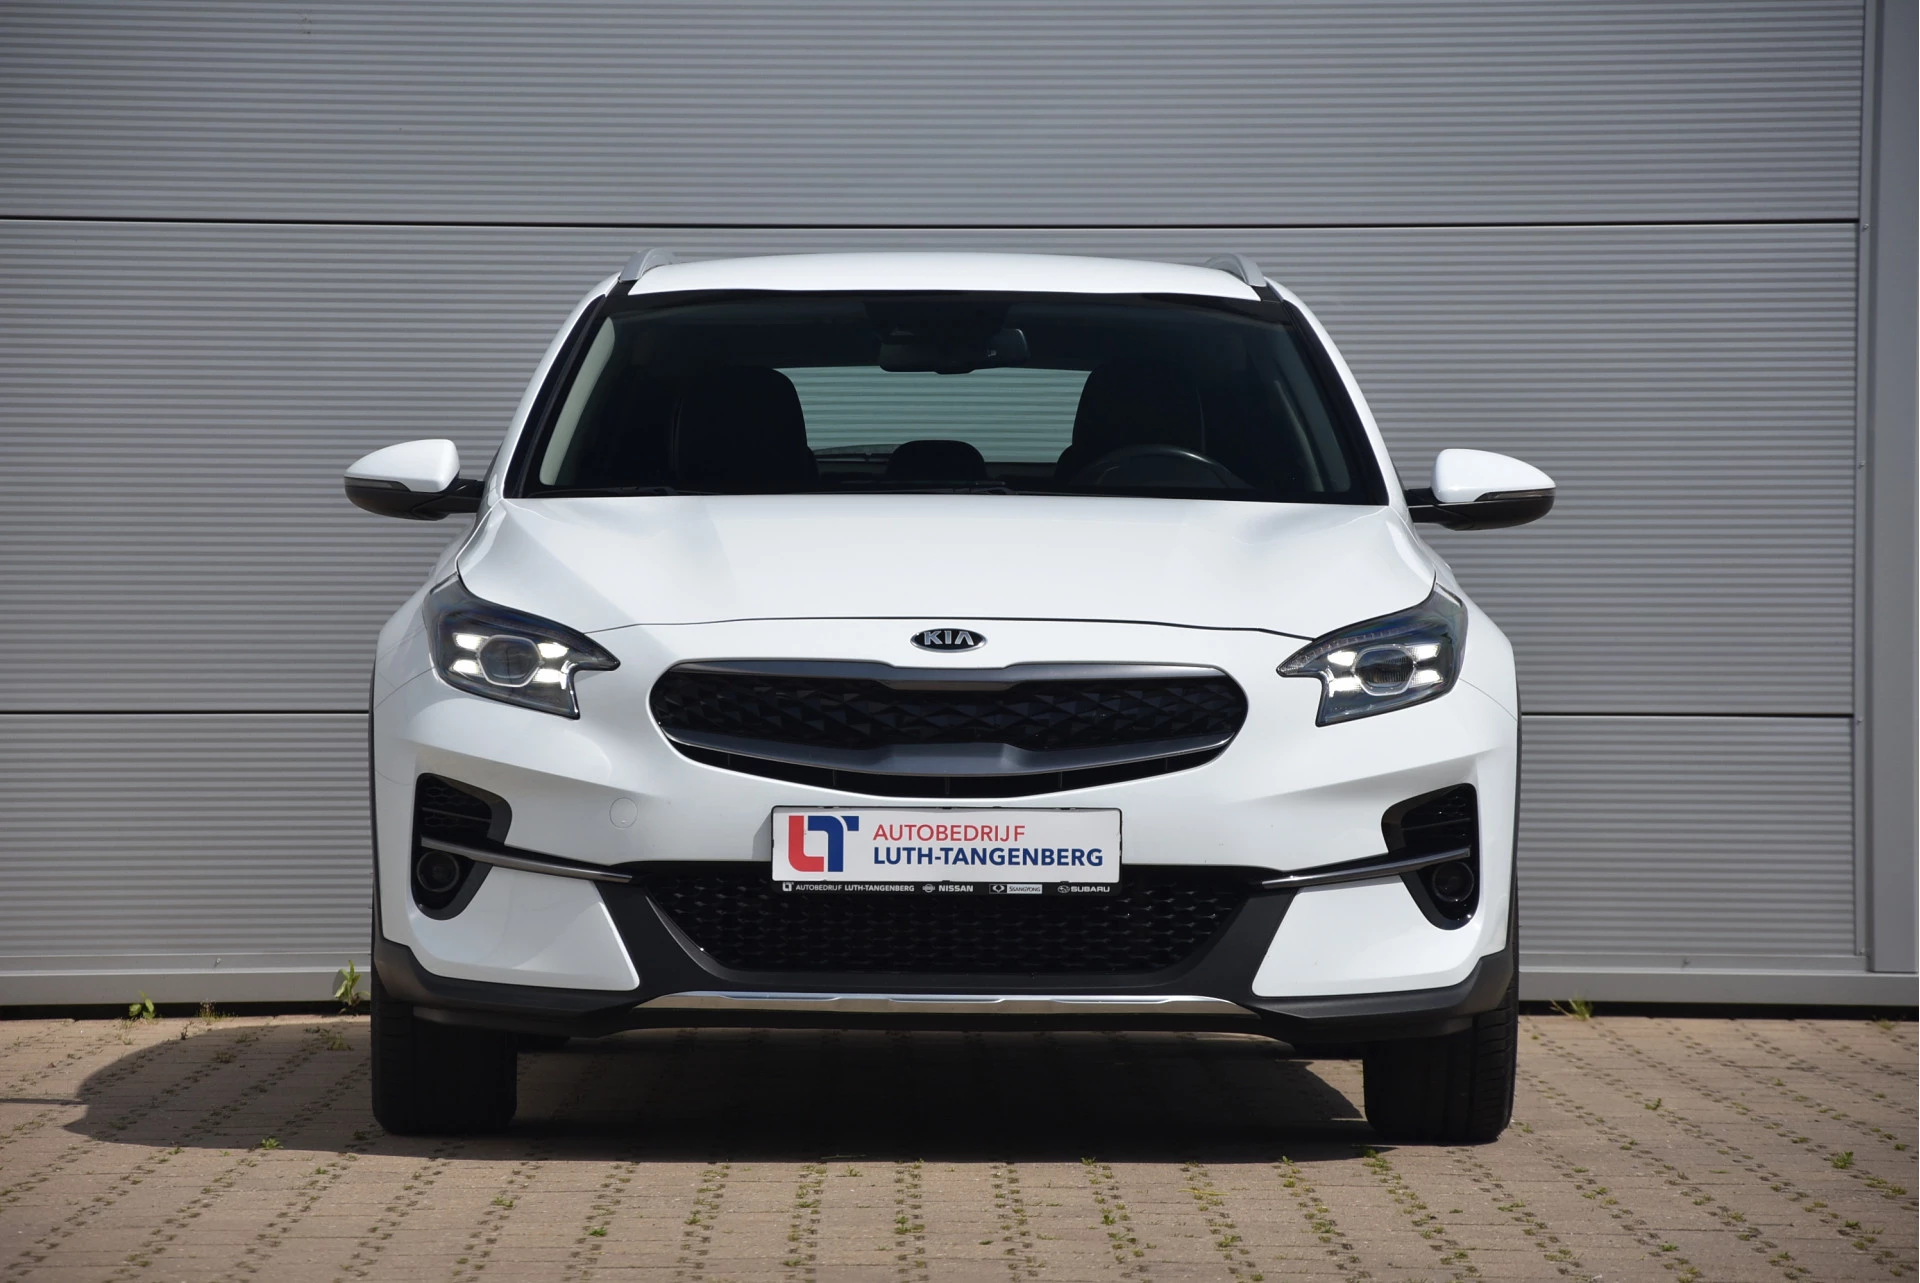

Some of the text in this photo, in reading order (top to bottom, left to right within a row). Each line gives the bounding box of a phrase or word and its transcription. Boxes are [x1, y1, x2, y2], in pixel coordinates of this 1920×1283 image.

[923, 630, 975, 645] KIA
[873, 824, 1026, 842] AUTOBEDRIJF
[874, 847, 1103, 867] LUTH-TANGENBERG
[845, 884, 915, 892] LUTH-TANGENBERG
